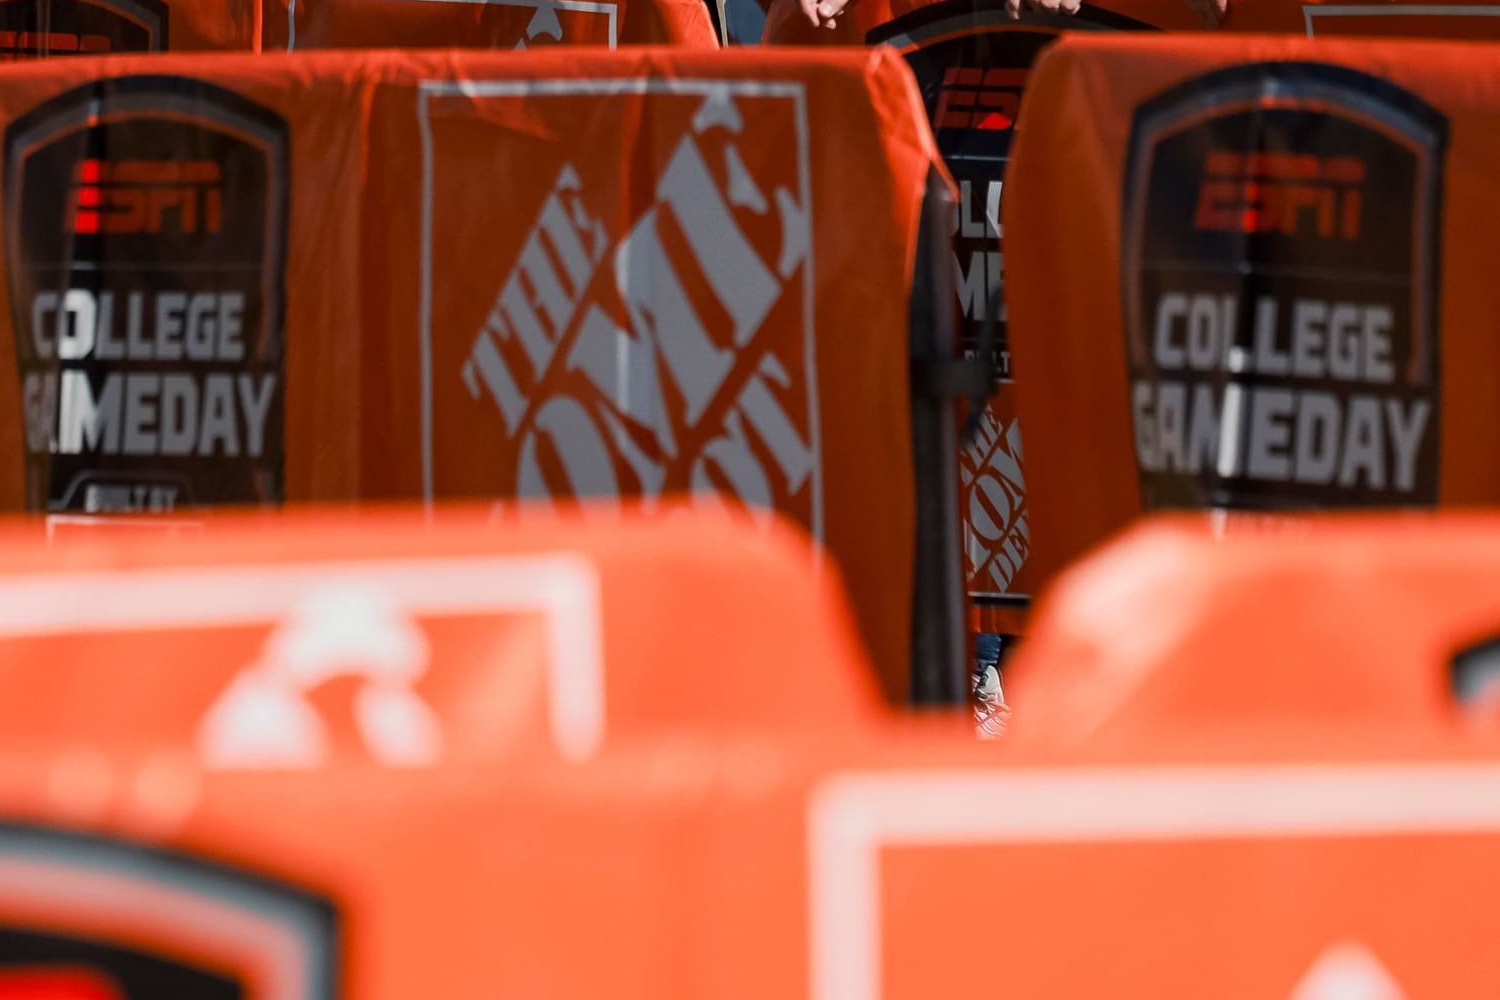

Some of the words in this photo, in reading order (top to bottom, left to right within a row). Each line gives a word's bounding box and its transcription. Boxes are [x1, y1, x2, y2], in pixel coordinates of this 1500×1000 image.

[64, 160, 221, 233] ESPN
[1195, 152, 1364, 238] ESPN
[32, 289, 244, 360] COLLEGE
[461, 162, 608, 440] THE
[1154, 294, 1396, 383] COLLEGE
[1133, 380, 1431, 492] GAMEDAY
